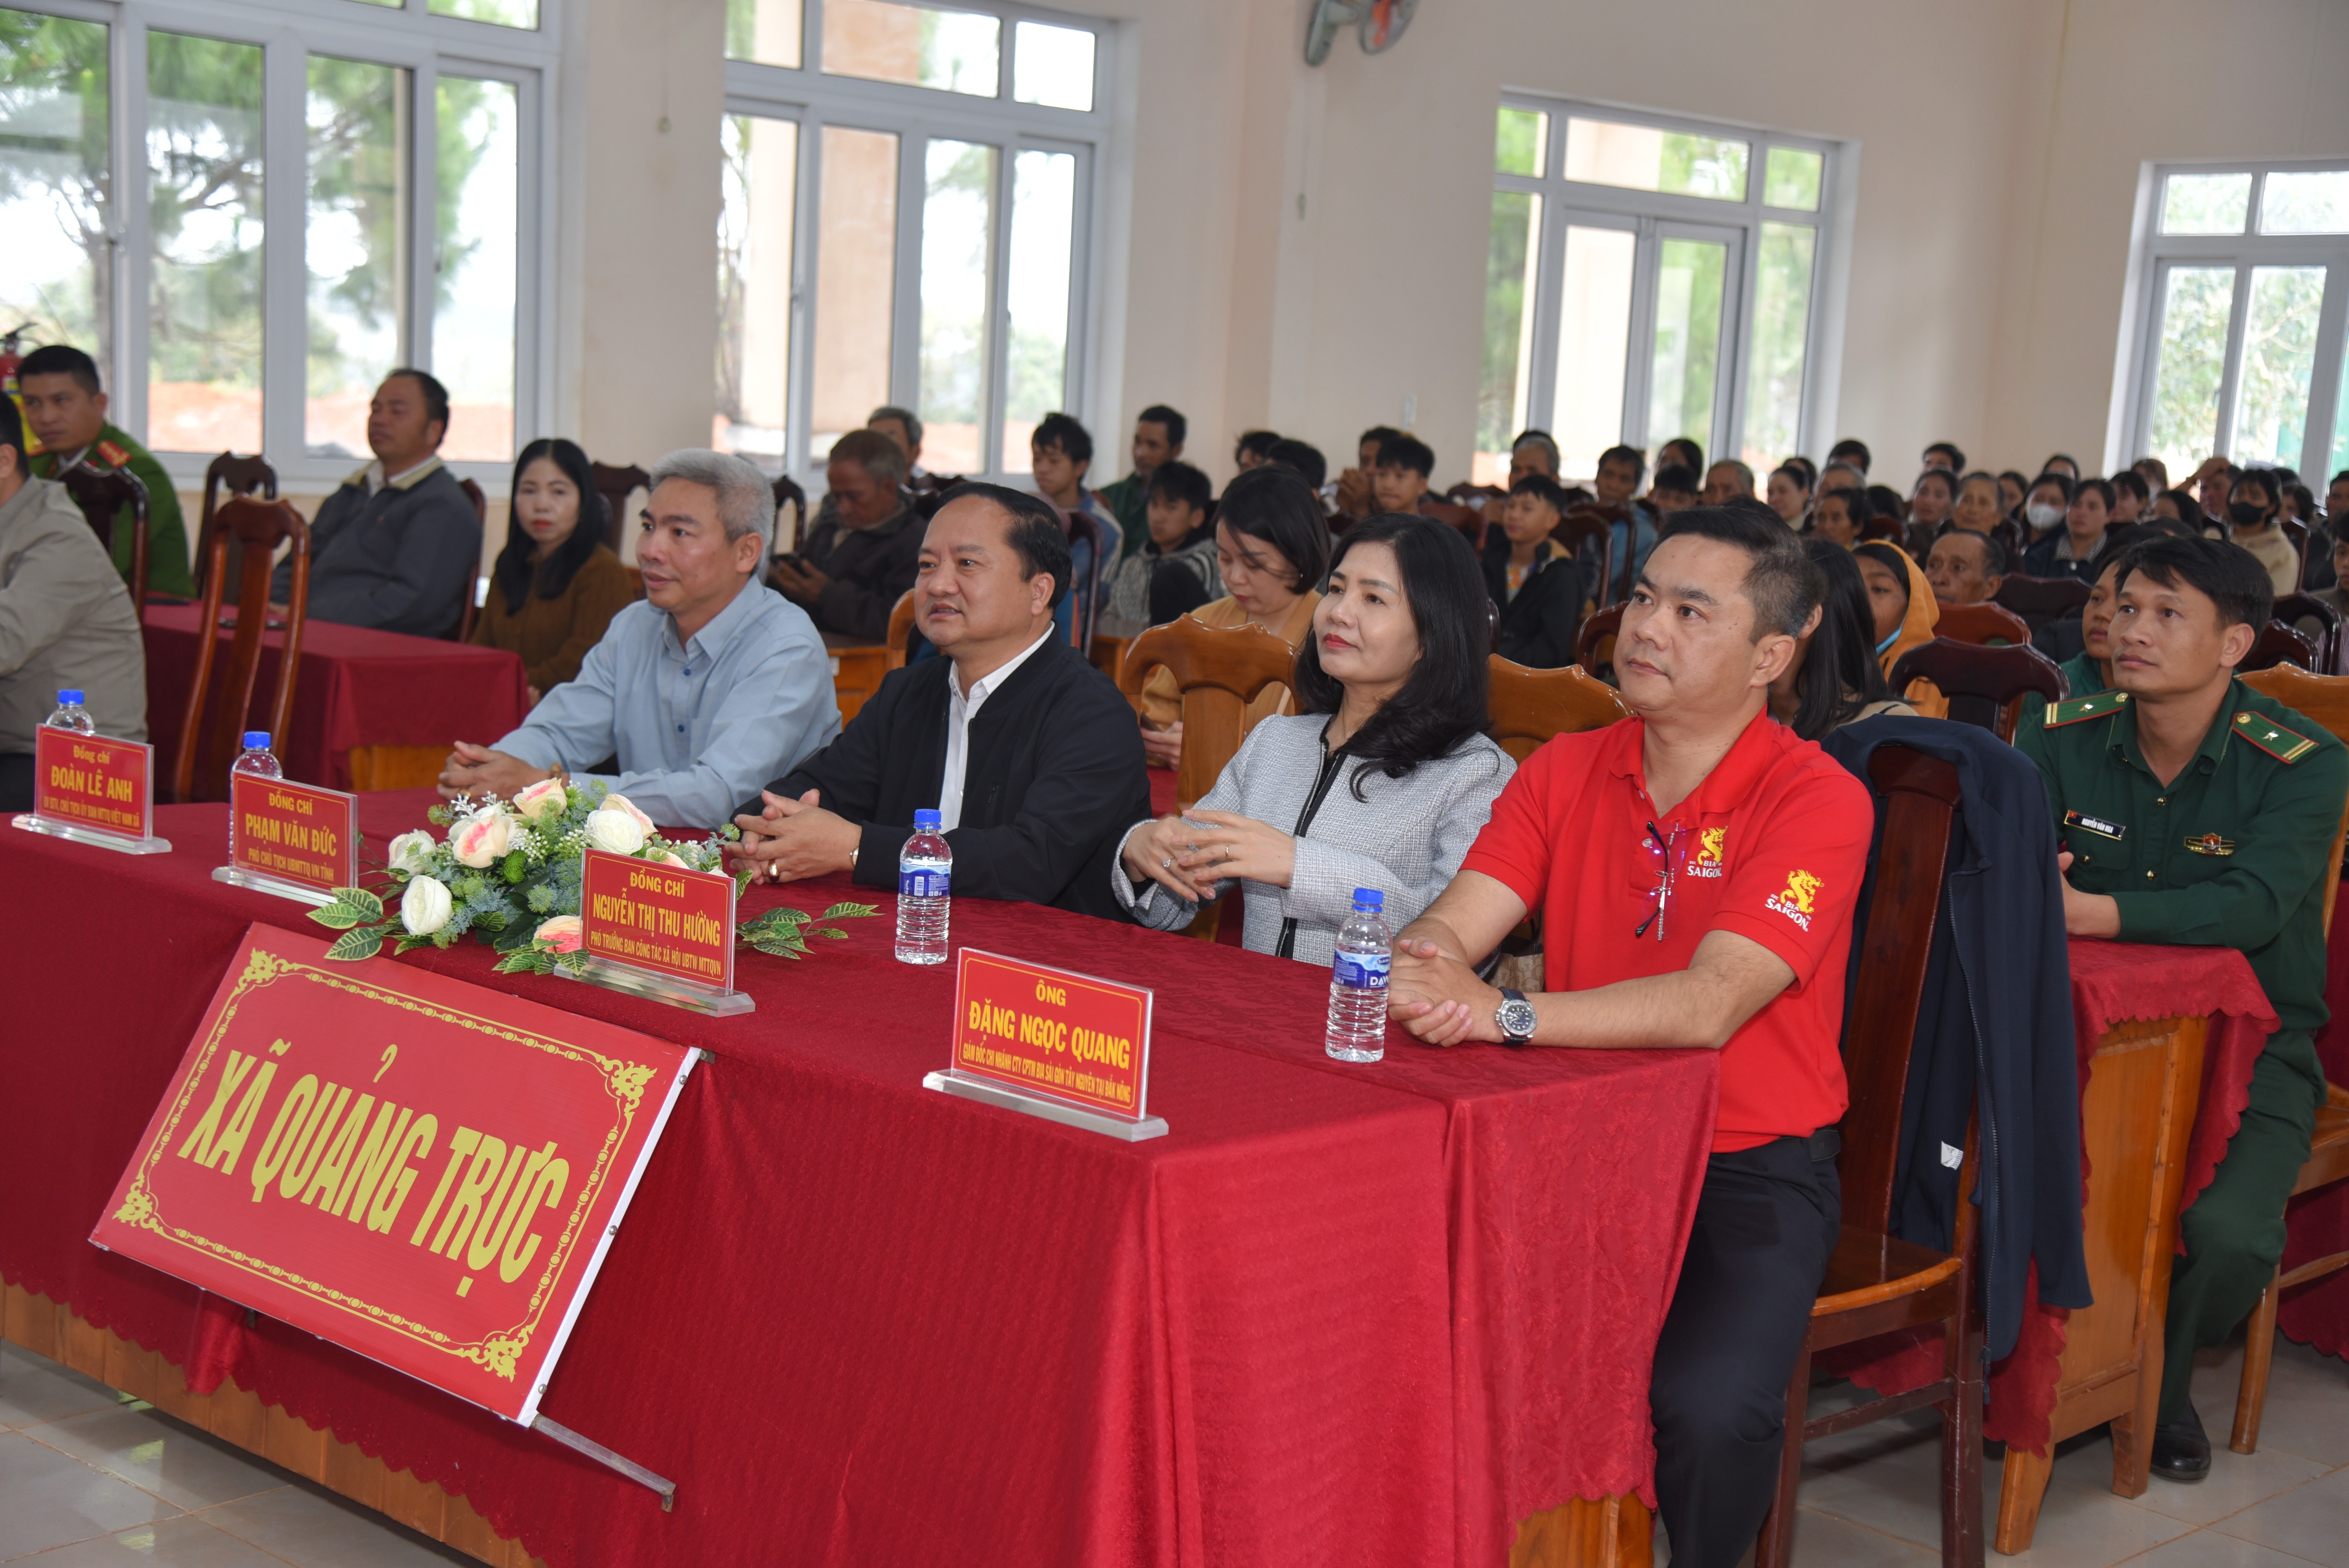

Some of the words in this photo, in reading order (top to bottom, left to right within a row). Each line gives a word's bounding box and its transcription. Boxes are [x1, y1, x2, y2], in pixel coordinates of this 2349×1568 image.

[73, 745, 95, 764] Đồng
[97, 750, 110, 764] chí
[51, 763, 85, 793] ĐOÀN
[88, 769, 103, 796] LÊ
[107, 777, 132, 802] ANH
[269, 789, 294, 812] ĐỒNG
[297, 799, 312, 815] CHÍ
[246, 813, 280, 845] PHẠM
[283, 820, 308, 850] VĂN
[312, 826, 337, 857] ĐỨC
[248, 846, 259, 862] PHÓ
[261, 848, 272, 866] CHỦ
[273, 854, 286, 871] TỊCH
[287, 857, 311, 878] UBMTTQ
[312, 864, 319, 878] VN
[321, 862, 334, 881] TỈNH
[1687, 866, 1721, 878] SAIGON
[630, 868, 661, 893] ĐỒNG
[665, 879, 686, 898] CHÍ
[593, 887, 635, 927] NGUYỄN
[638, 903, 655, 937] THỊ
[658, 908, 680, 937] THU
[683, 910, 720, 948] HƯỜNG
[1765, 898, 1809, 930] SAIGON
[1784, 901, 1799, 911] BIA
[591, 928, 601, 946] PHÓ
[602, 930, 623, 952] TRƯỞNG
[624, 938, 635, 955] BAN
[636, 938, 650, 959] CÔNG
[651, 942, 662, 961] TÁC
[663, 945, 670, 964] XÃ
[672, 947, 681, 968] HỘI
[682, 952, 698, 970] UBTW
[699, 957, 721, 977] MTTQVN
[1036, 979, 1066, 1007] ÔNG
[969, 998, 1016, 1041] ĐẶNG
[1019, 1013, 1067, 1055] NGỌC
[1071, 1026, 1130, 1070] QUANG
[963, 1039, 975, 1060] GIÁM
[976, 1041, 986, 1064] ĐỐC
[986, 1049, 995, 1067] CHI
[995, 1048, 1012, 1071] NHÁNH
[1012, 1056, 1022, 1073] CTY
[1022, 1058, 1036, 1078] CPTM
[1036, 1062, 1045, 1079] BIA
[1045, 1060, 1053, 1082] SÀI
[1054, 1063, 1065, 1084] GÒN
[1066, 1066, 1076, 1088] TÂY
[1076, 1071, 1095, 1093] NGUYÊN
[1096, 1078, 1105, 1098] TẠI
[1105, 1074, 1116, 1099] ĐẮK
[1116, 1080, 1131, 1103] NÔNG
[177, 1037, 292, 1174] XÃ
[251, 1043, 438, 1235] QUẢNG
[410, 1125, 570, 1298] TRỰC
